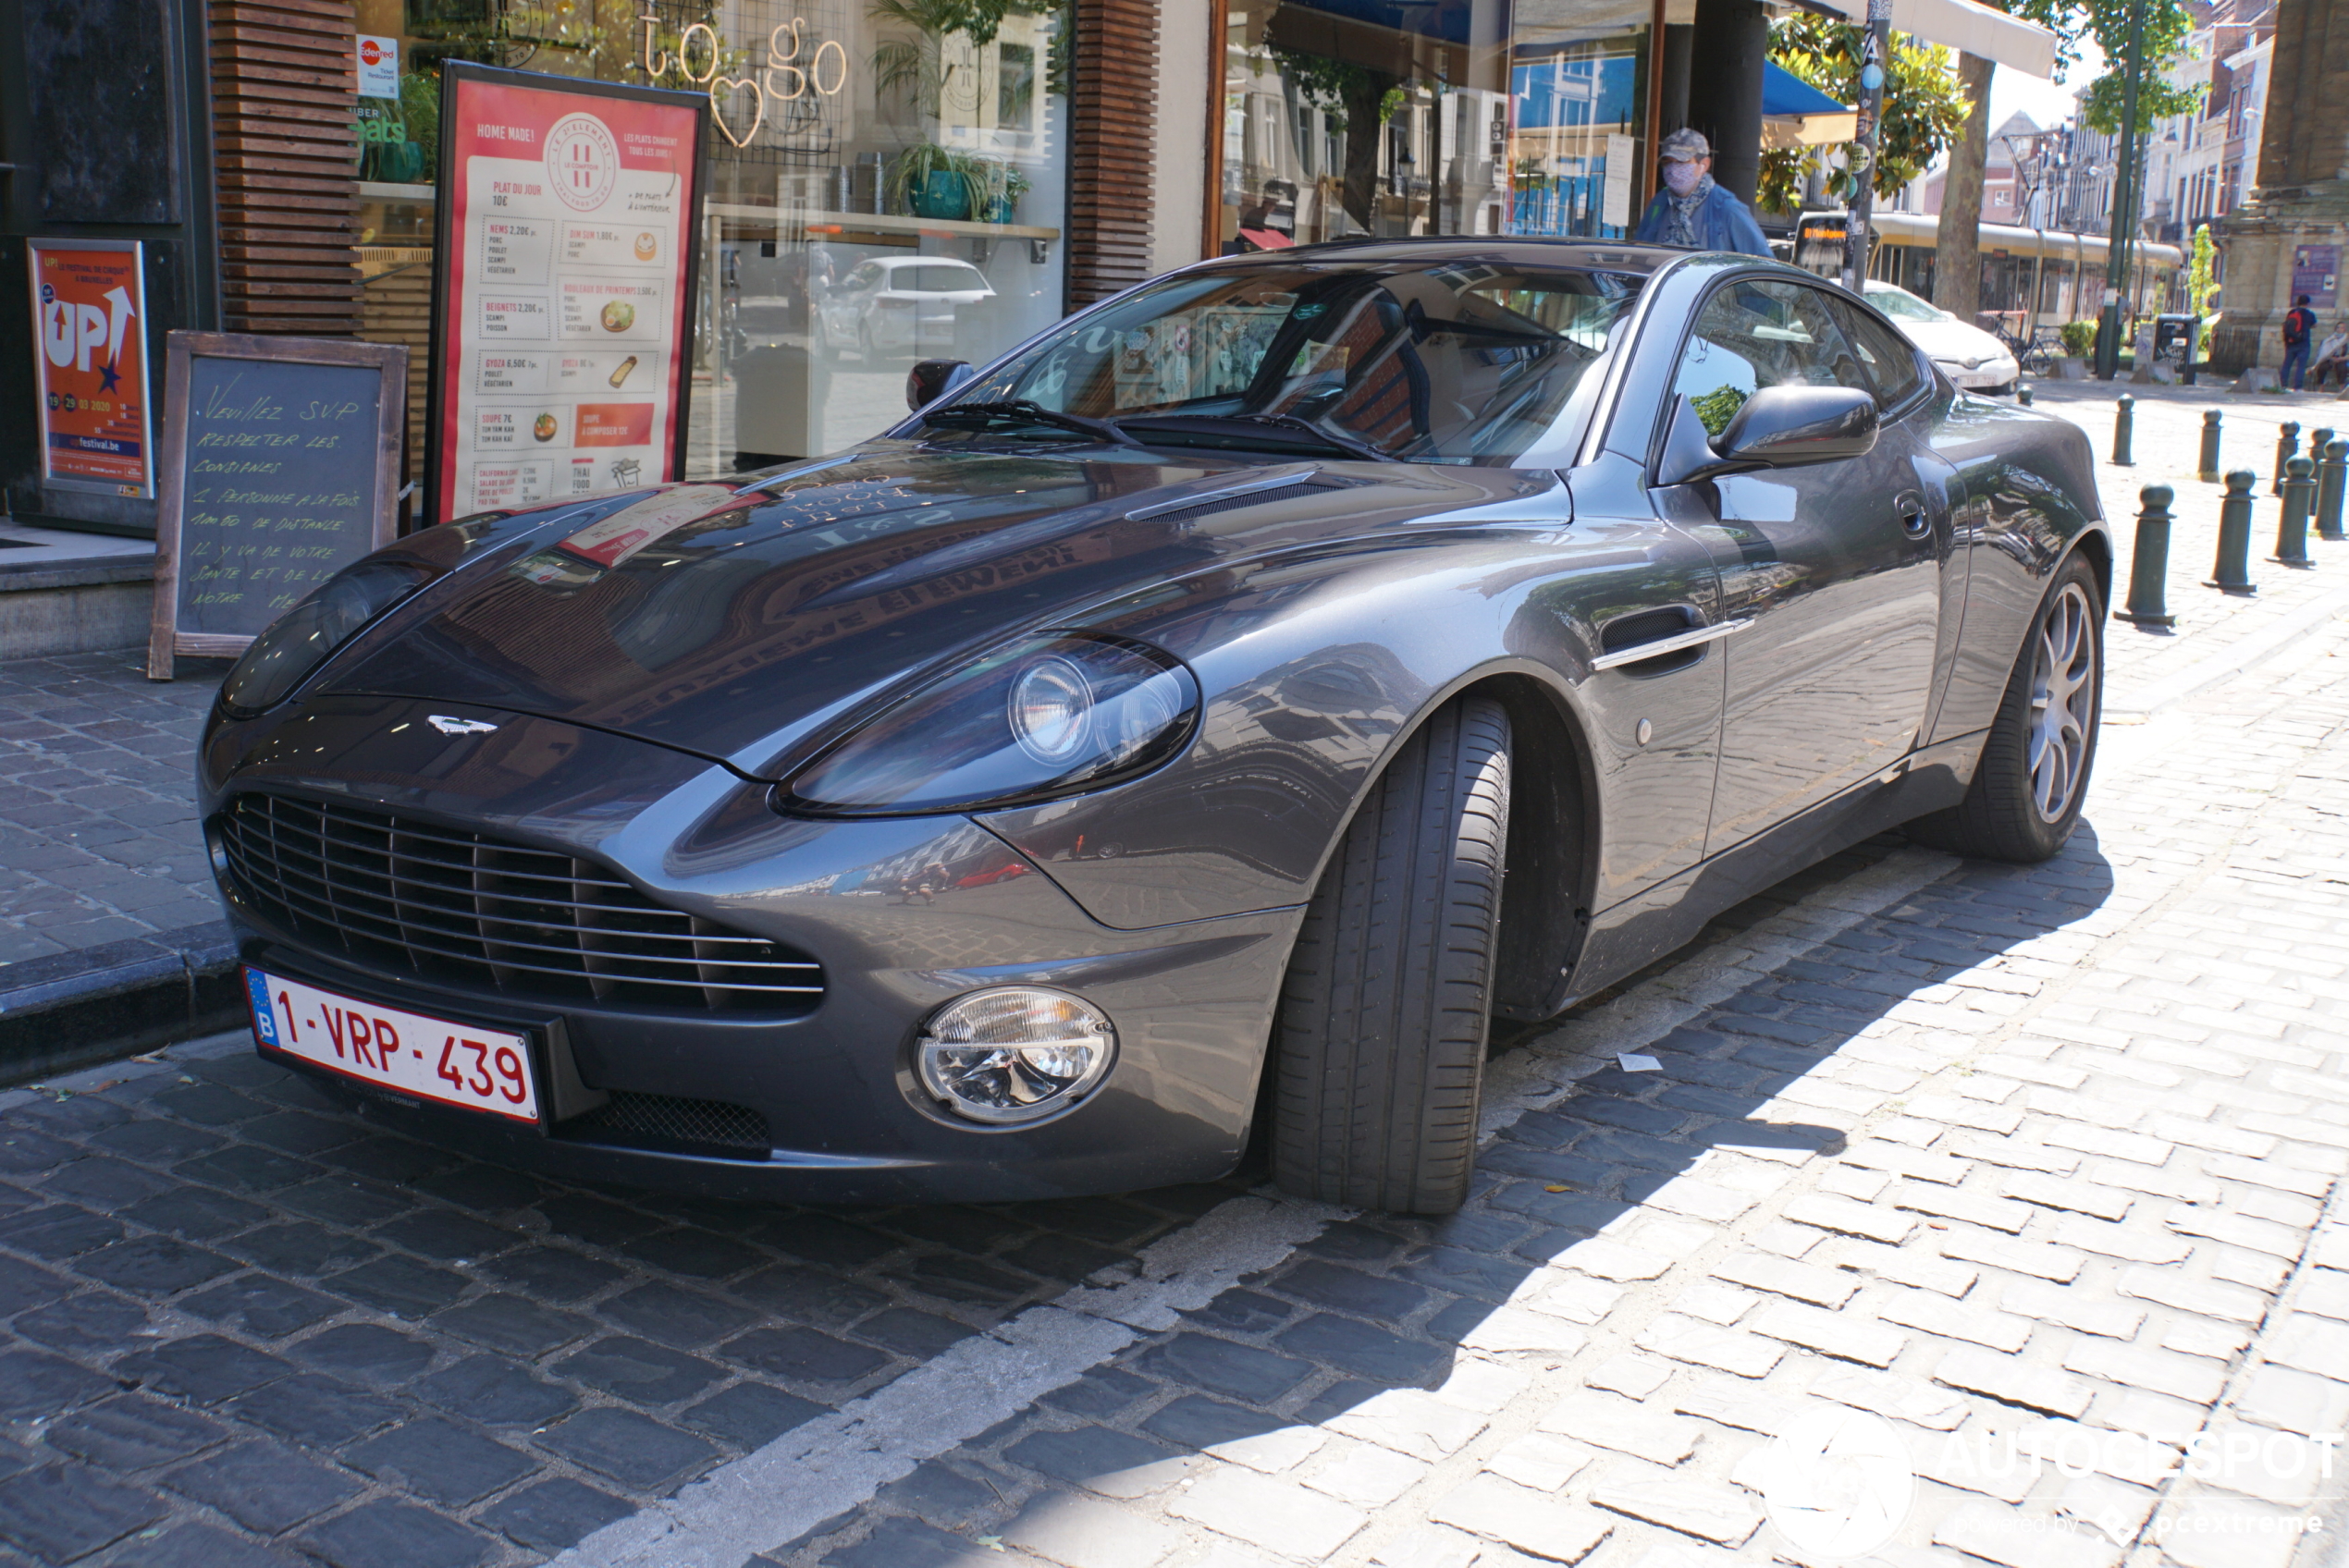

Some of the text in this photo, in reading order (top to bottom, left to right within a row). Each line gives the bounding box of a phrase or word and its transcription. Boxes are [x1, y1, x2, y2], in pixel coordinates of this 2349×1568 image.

[361, 46, 393, 59] Edenred
[638, 15, 846, 101] to go
[368, 72, 394, 80] Restaurant
[477, 124, 535, 142] HOME MADE!
[624, 133, 633, 142] LES
[635, 134, 651, 144] PLATS
[572, 123, 611, 156] ELEMENT
[629, 146, 643, 155] TOUS
[645, 148, 654, 156] LES
[493, 181, 541, 195] PLAT DU JOUR
[493, 195, 508, 206] 10€
[490, 225, 509, 234] NEMS
[510, 226, 529, 236] 2,20€
[488, 236, 502, 244] PORC
[488, 246, 507, 254] POULET
[486, 302, 517, 312] BEIGNETS
[518, 303, 536, 313] 2,20€
[486, 359, 505, 368] GYOZA
[507, 359, 525, 368] 6,50€
[49, 396, 110, 412] 19 29 03 2020
[482, 414, 511, 423] SOUPE 7€
[197, 433, 300, 447] RESPECTER
[573, 468, 590, 477] THAI
[572, 479, 590, 488] FOOD
[216, 489, 295, 504] PERSONNE
[252, 518, 271, 530] DE
[191, 541, 211, 556] IL
[238, 545, 256, 557] VA
[262, 546, 282, 559] DE
[289, 546, 336, 559] VOTRE
[190, 565, 241, 582] SANTE
[250, 567, 280, 580] ET
[283, 569, 306, 582] DE
[192, 592, 244, 605] NOTRE
[257, 1011, 275, 1037] B
[277, 990, 526, 1104] 1-VRP-439
